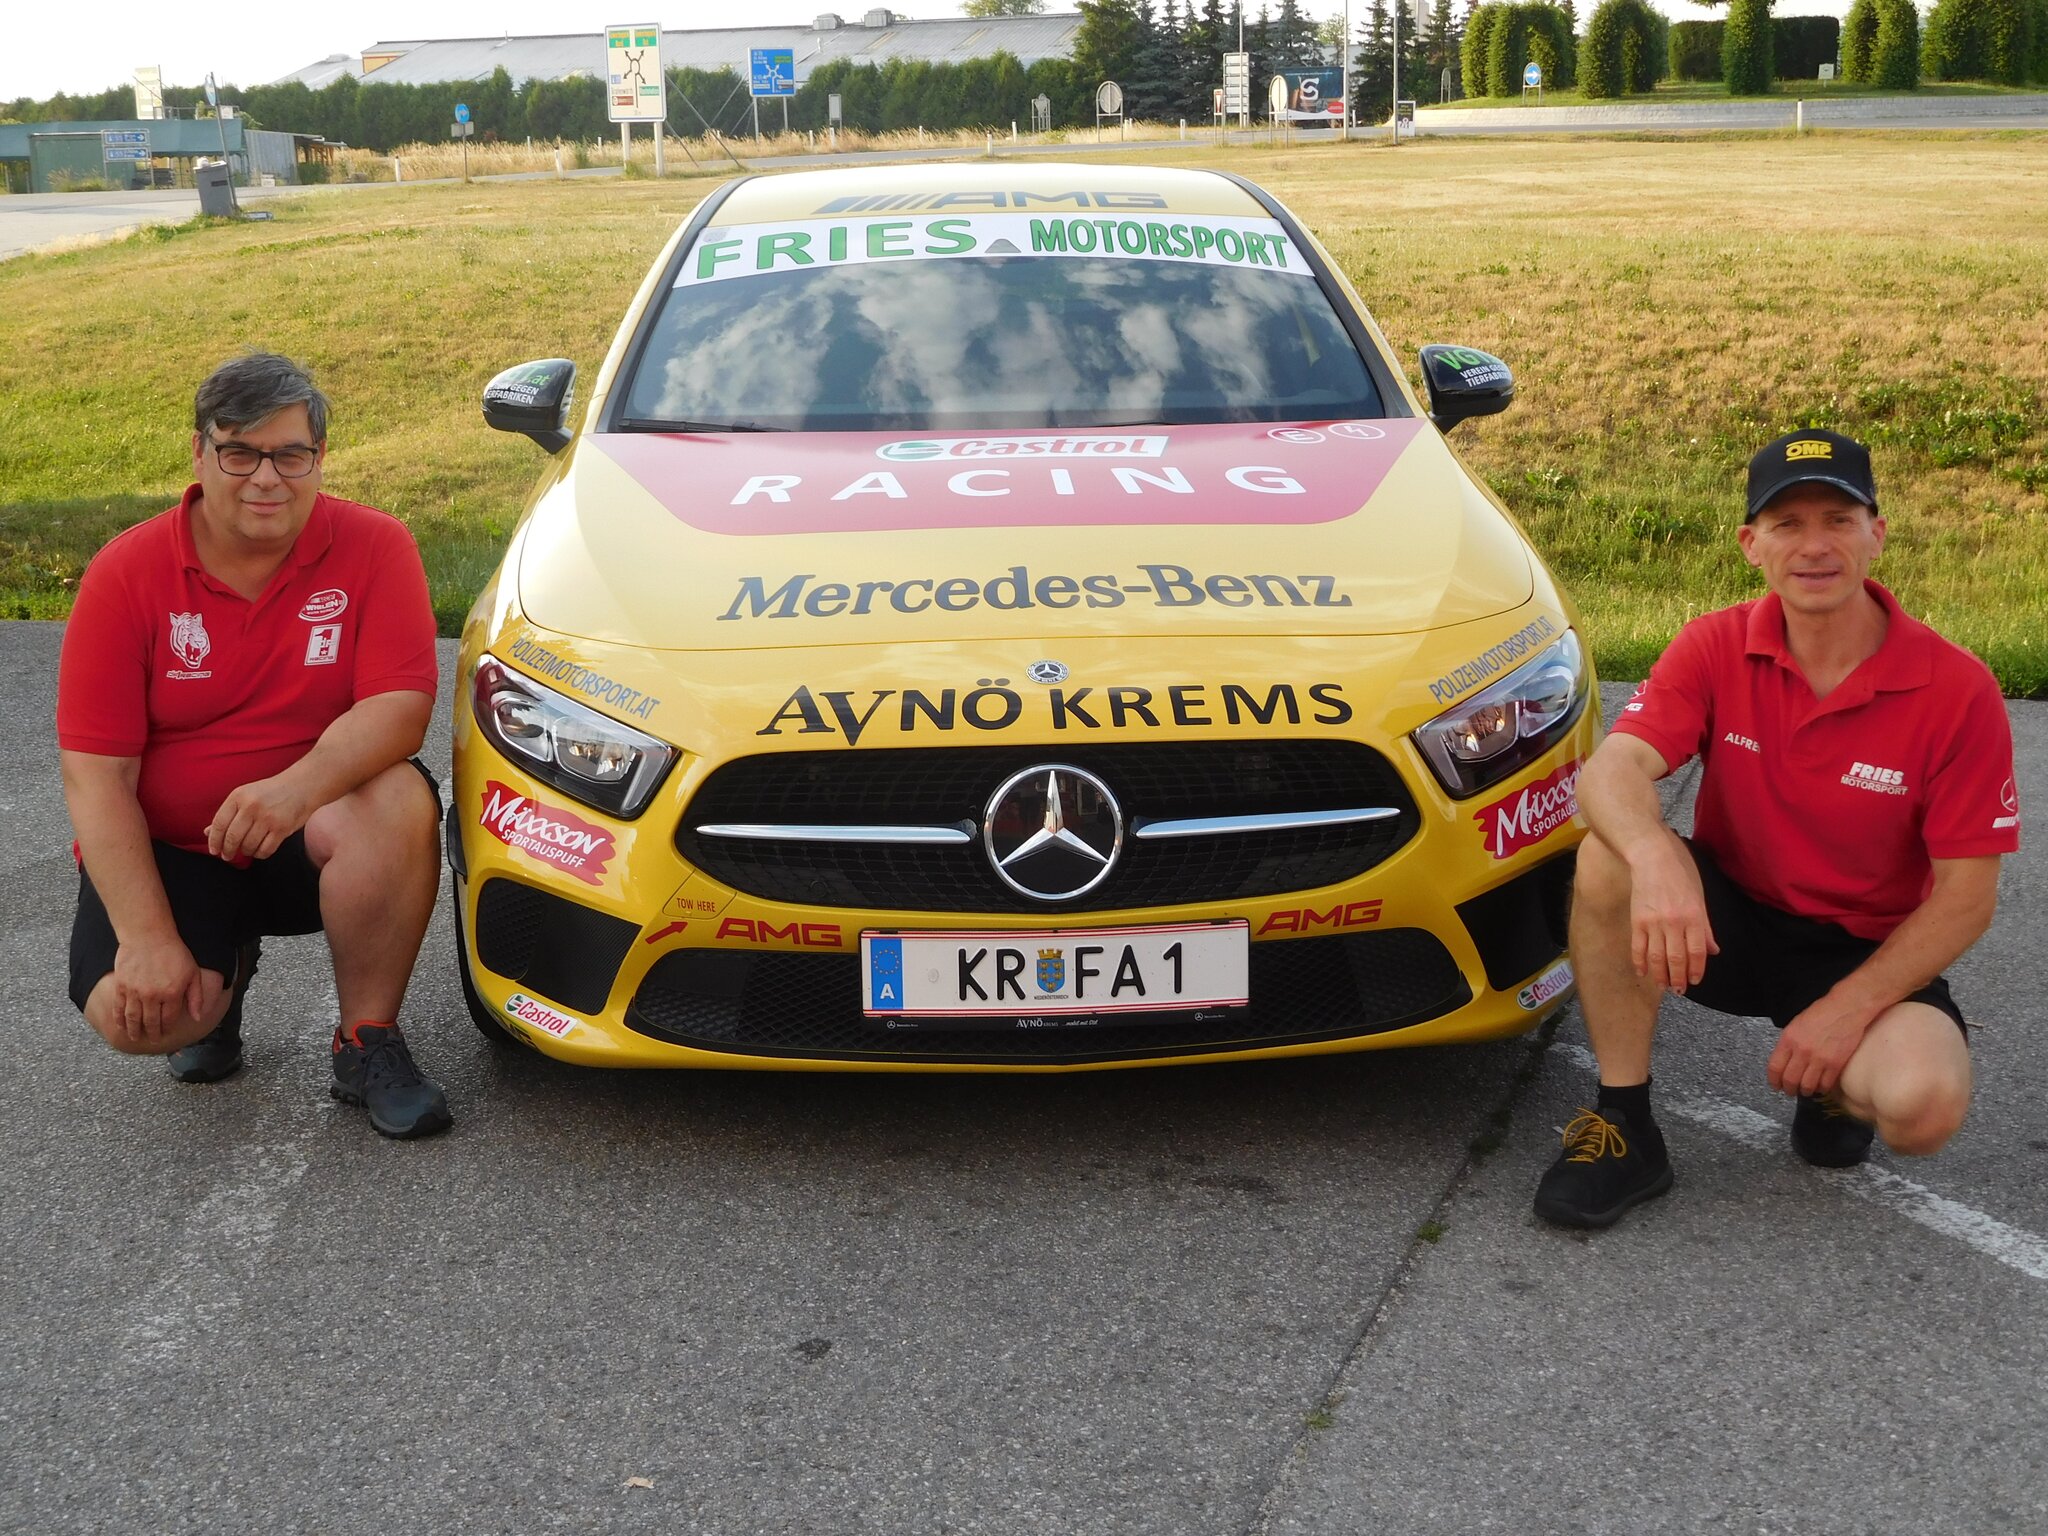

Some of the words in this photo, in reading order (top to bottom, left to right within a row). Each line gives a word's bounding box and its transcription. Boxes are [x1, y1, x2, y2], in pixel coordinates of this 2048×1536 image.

[926, 191, 1168, 209] AMG
[697, 219, 976, 279] FRIES
[1030, 218, 1288, 268] MOTORSPORT
[1460, 365, 1491, 379] VEREIN
[510, 383, 539, 396] GEGEN
[949, 437, 1150, 458] Castrol
[1786, 442, 1832, 457] OMP
[729, 465, 1307, 506] RACING
[716, 565, 1353, 621] Mercedes-Benz
[1428, 615, 1557, 705] POLIZEIMOTORSPORT.AT
[507, 638, 661, 720] POLIZEIMOTORSPORT.AT
[755, 678, 1023, 746] AVNÖ
[1050, 682, 1354, 730] KREMS
[1841, 776, 1909, 797] MOTORSPORT
[1849, 761, 1904, 786] FRIES
[1532, 798, 1578, 837] SPORTAUS
[501, 828, 586, 869] SPORTAUSPUFF
[676, 897, 693, 910] TOW
[697, 899, 716, 913] HERE
[1255, 898, 1384, 936] AMG
[715, 917, 843, 947] AMG
[957, 947, 1026, 1001] KR
[1074, 943, 1146, 998] FA
[1162, 941, 1183, 994] 1
[1532, 964, 1572, 1001] Castrol
[879, 983, 895, 999] A
[517, 1001, 570, 1034] Castrol
[1016, 1017, 1043, 1029] AVNÖ
